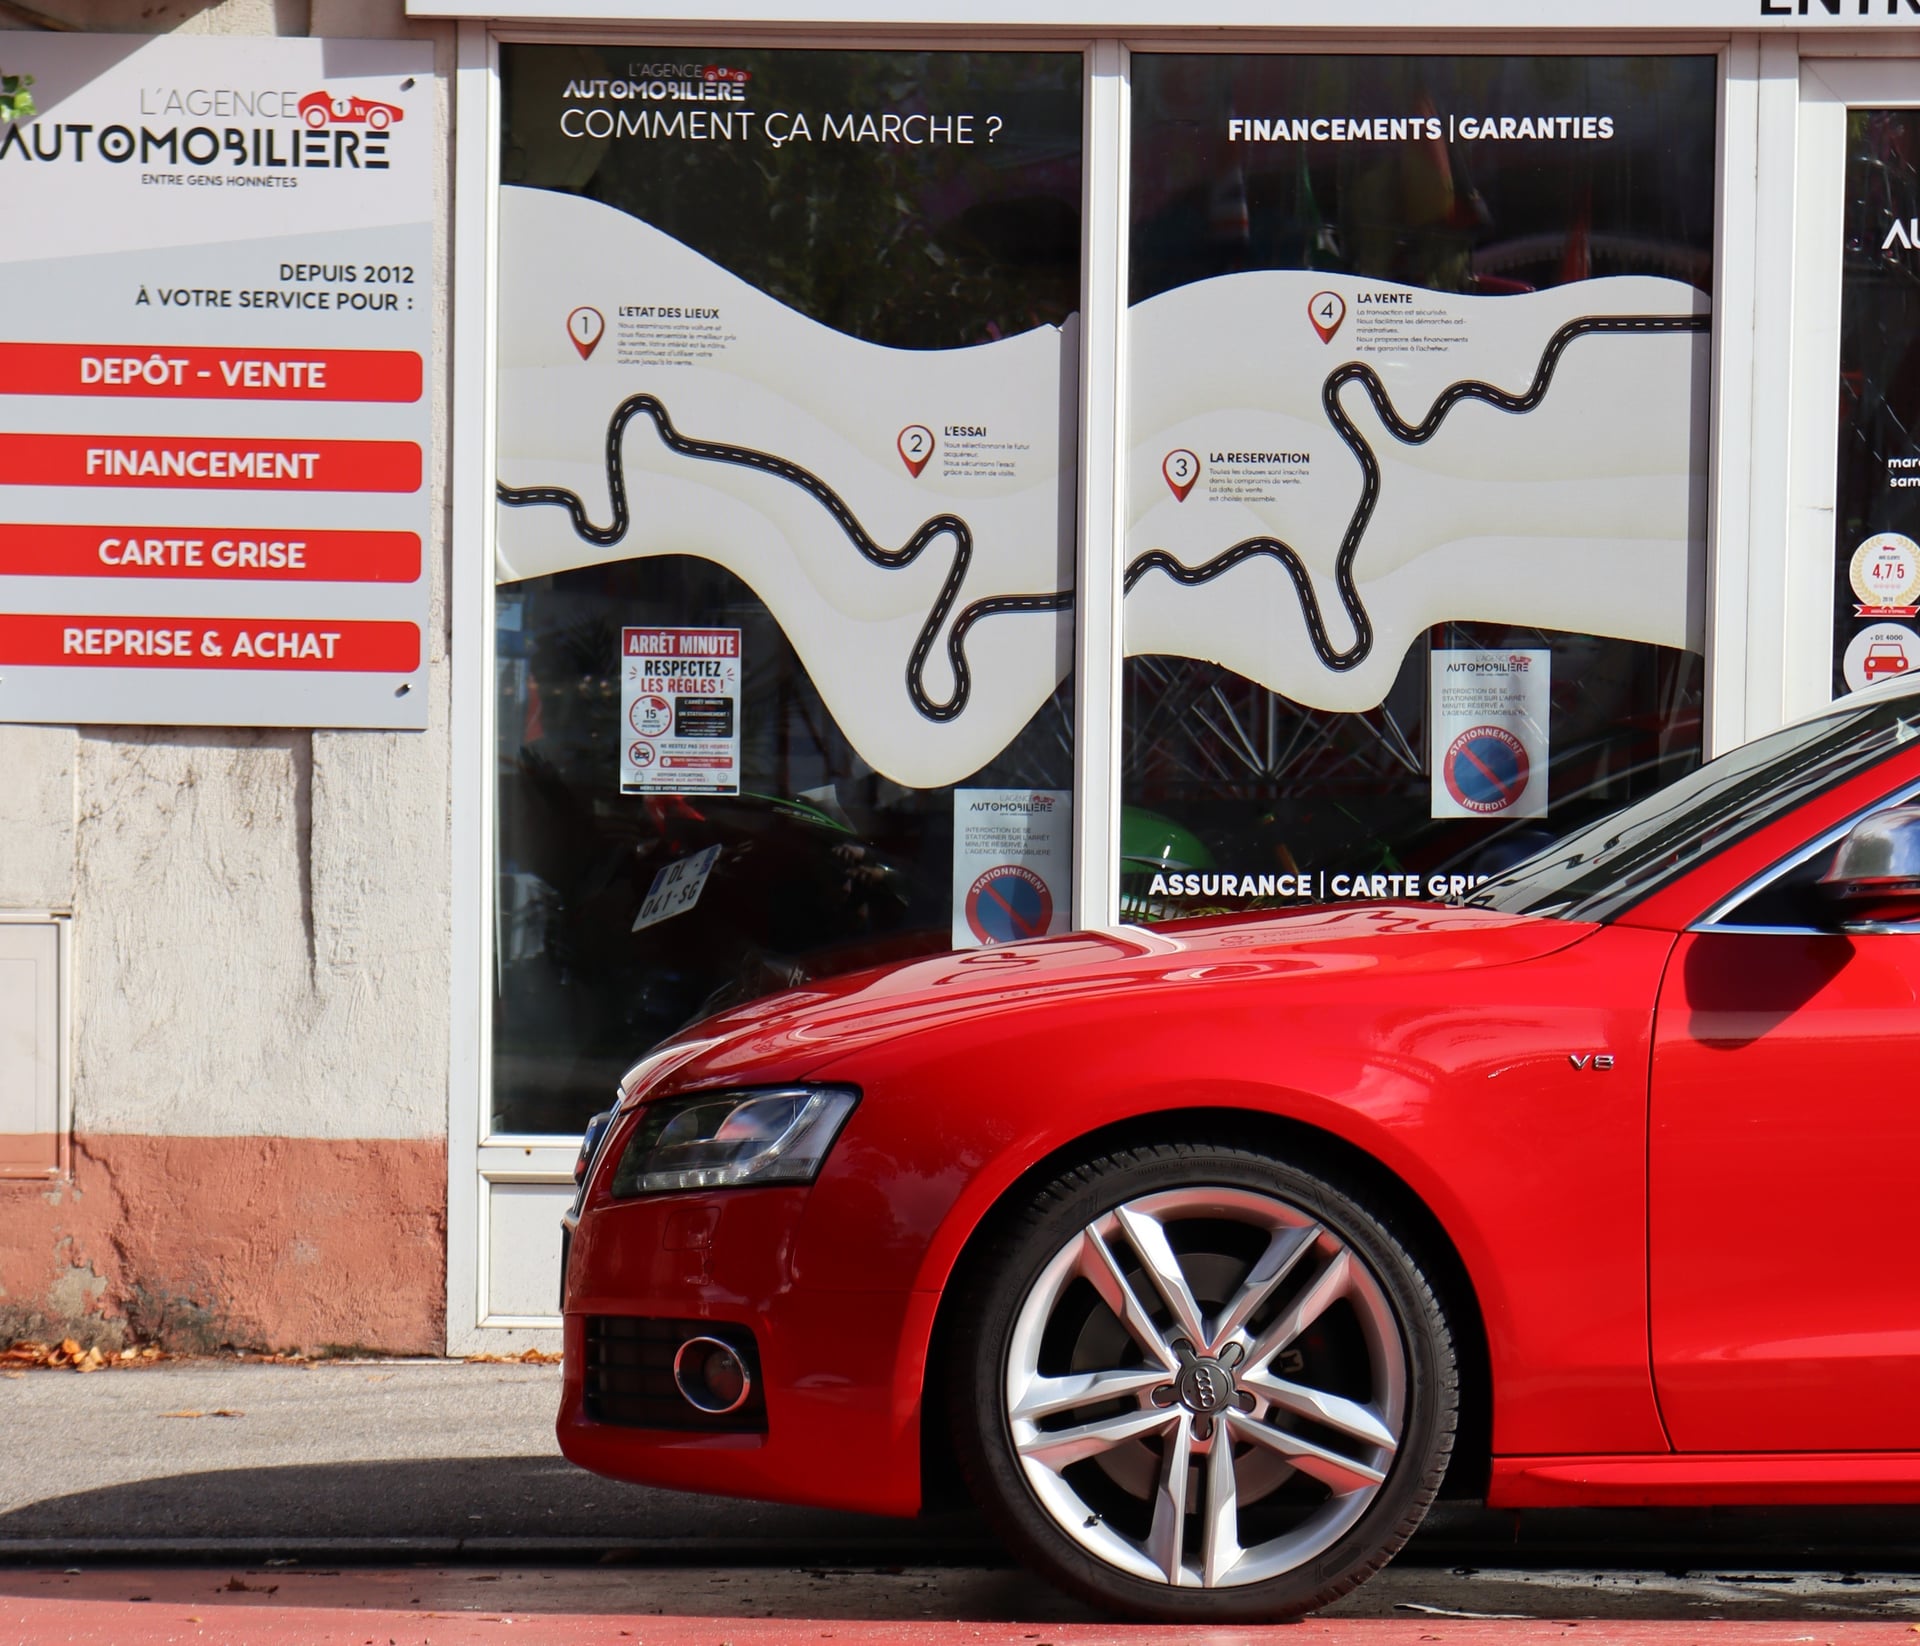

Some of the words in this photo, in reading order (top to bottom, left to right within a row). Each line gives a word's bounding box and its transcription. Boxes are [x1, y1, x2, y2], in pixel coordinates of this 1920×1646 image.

[140, 88, 298, 119] L'AGENCE
[560, 109, 755, 139] COMMENT
[764, 112, 811, 148] ÇA
[822, 113, 975, 144] MARCHE
[985, 116, 1003, 143] ?
[1228, 118, 1441, 141] FINANCEMENTS
[1458, 116, 1614, 140] GARANTIES
[141, 174, 183, 186] ENTRE
[187, 174, 223, 187] GENS
[280, 264, 357, 283] DEPUIS
[363, 266, 414, 284] 2012
[136, 284, 151, 306] À
[157, 289, 232, 308] VOTRE
[239, 291, 330, 310] SERVICE
[336, 293, 398, 311] POUR
[1357, 293, 1372, 303] LA
[1374, 293, 1413, 303] VENTE
[618, 306, 655, 317] L'ETAT
[658, 307, 681, 318] DES
[685, 308, 720, 319] LIEUX
[1320, 301, 1333, 318] 4
[582, 316, 588, 334] 1
[80, 354, 189, 386] DEPÔT
[219, 360, 327, 388] VENTE
[944, 426, 986, 437] L'ESSAI
[910, 434, 923, 452] 2
[86, 448, 320, 480] FINANCEMENT
[1175, 458, 1188, 477] 3
[1210, 453, 1224, 462] LA
[1227, 453, 1309, 463] RESERVATION
[98, 539, 204, 566] CARTE
[211, 541, 306, 568] GRISE
[63, 628, 192, 656] REPRISE
[199, 631, 223, 657] &
[232, 632, 341, 660] ACHAT
[629, 632, 675, 654] ARRÊT
[680, 634, 735, 655] MINUTE
[645, 660, 721, 677] RESPECTEZ
[641, 678, 663, 693] LES
[645, 709, 656, 719] 15
[1450, 728, 1523, 757] STATIONNEMENT
[1463, 798, 1508, 811] INTERDIT
[972, 867, 1047, 895] STATIONNEMENT
[1149, 873, 1312, 897] ASSURANCE
[1331, 874, 1420, 897] CARTE
[1569, 1053, 1614, 1071] V8
